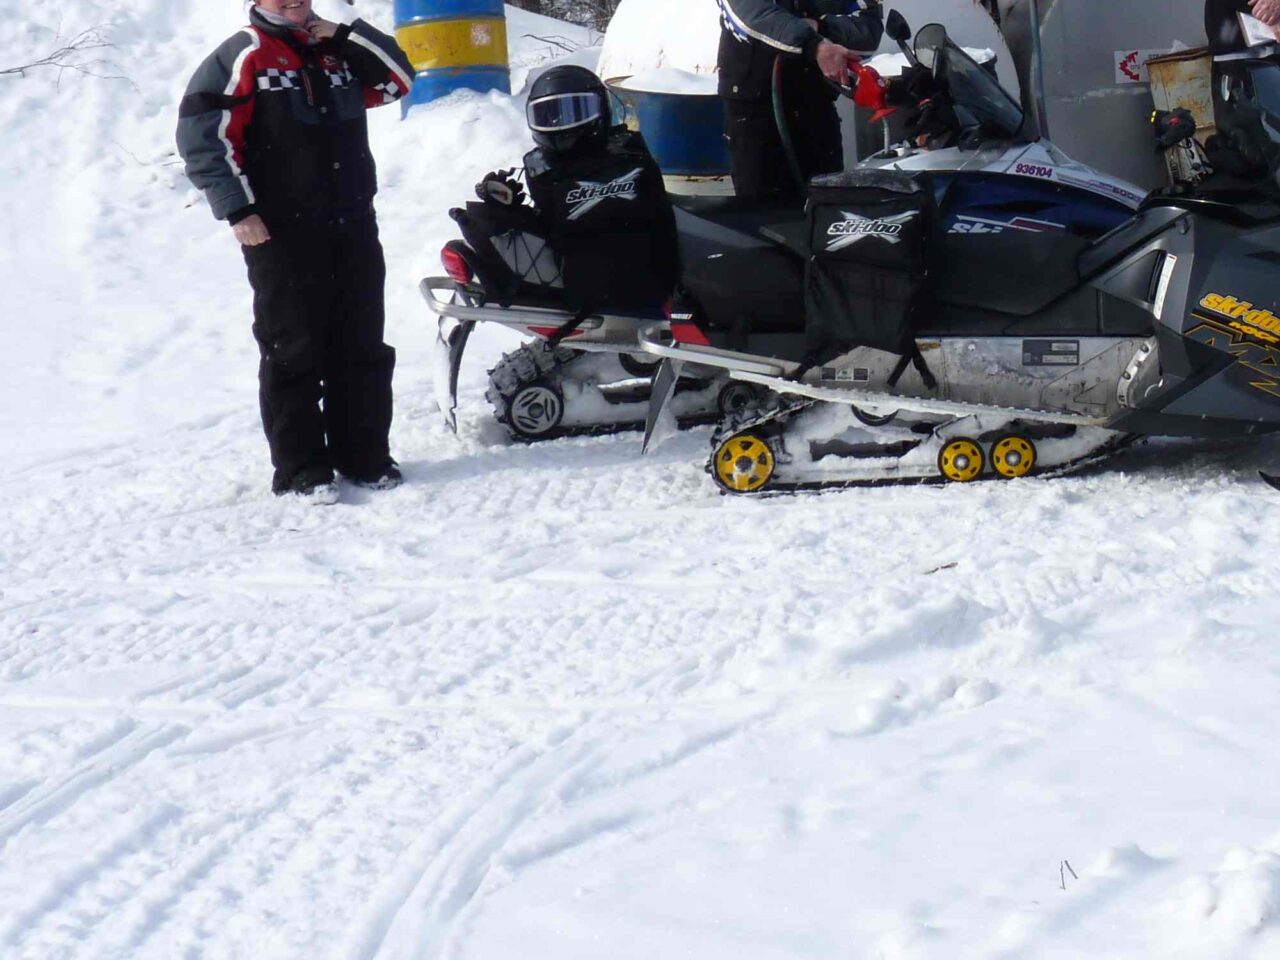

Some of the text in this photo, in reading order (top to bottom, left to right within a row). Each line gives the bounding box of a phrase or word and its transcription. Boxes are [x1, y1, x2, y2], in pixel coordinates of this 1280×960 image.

[1015, 163, 1053, 178] 936104
[566, 180, 635, 203] ski-doo
[827, 219, 902, 236] ski-doo
